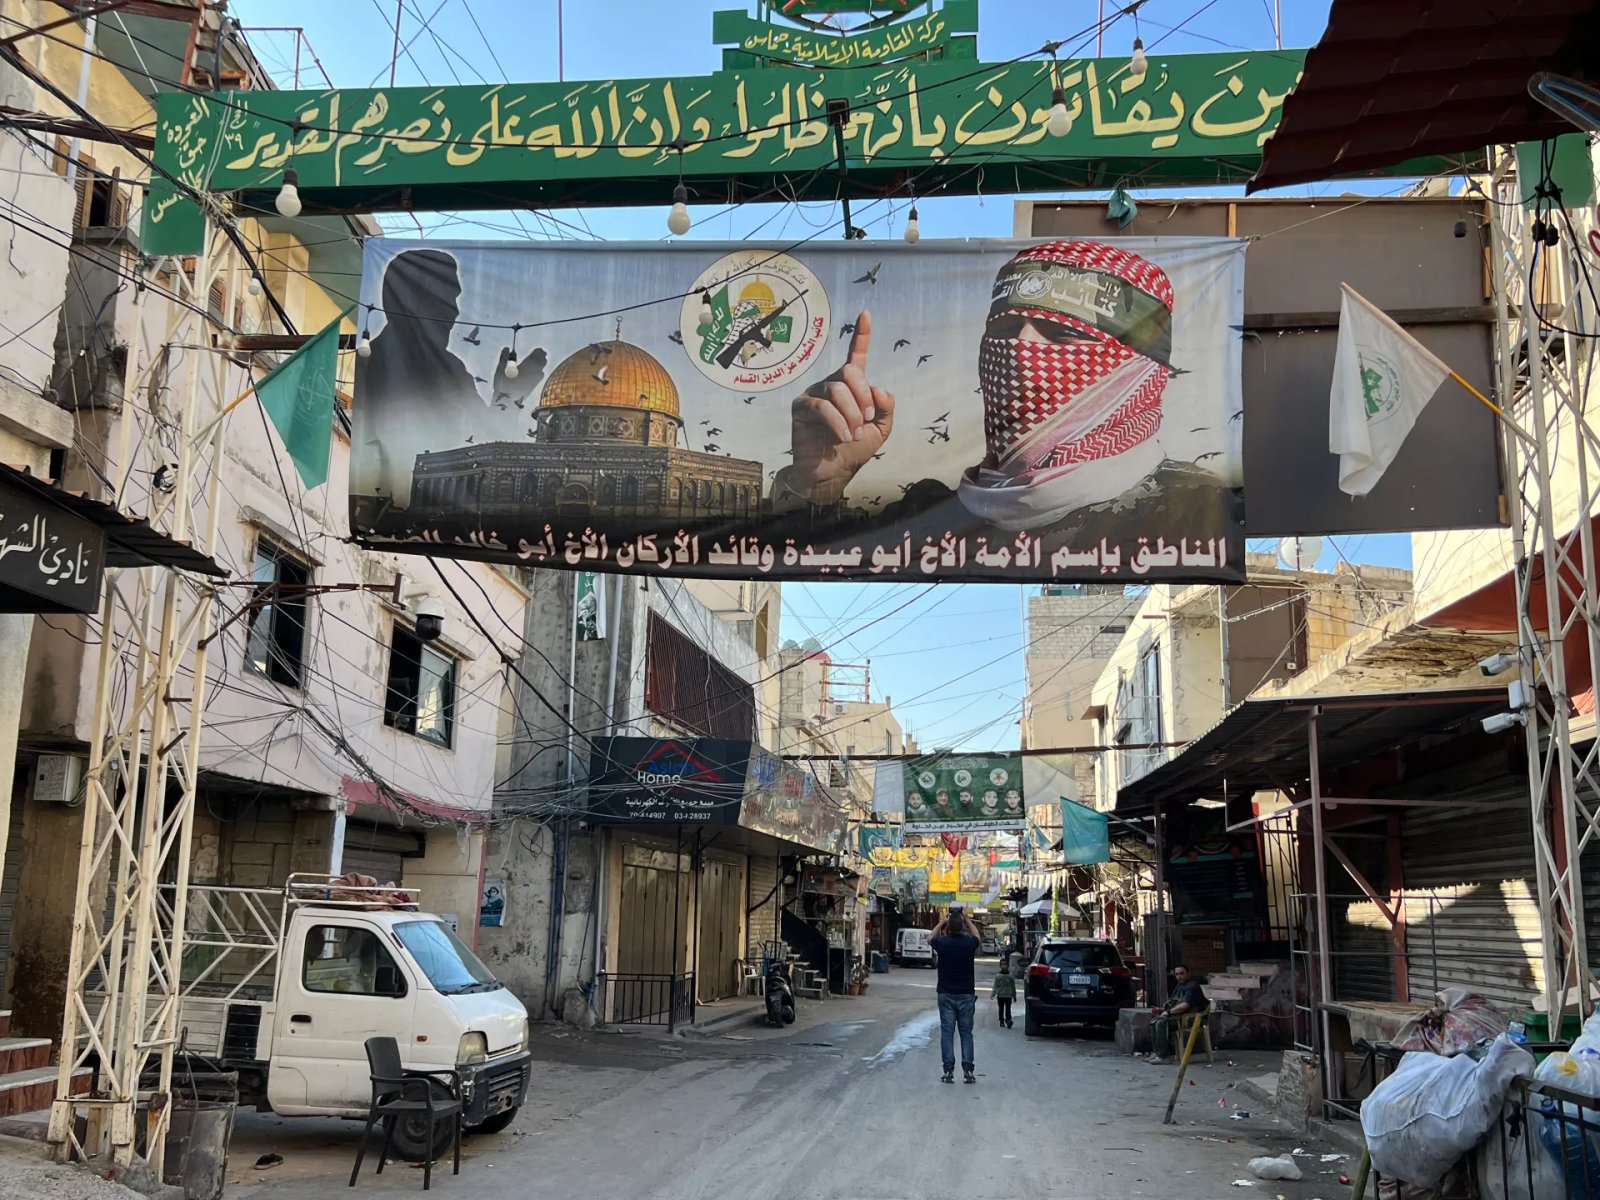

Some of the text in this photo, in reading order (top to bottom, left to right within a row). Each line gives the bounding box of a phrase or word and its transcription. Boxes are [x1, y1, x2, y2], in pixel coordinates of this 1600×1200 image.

[745, 29, 789, 50] حماس
[863, 25, 914, 58] المقاومة
[920, 12, 945, 44] حركة
[224, 132, 244, 150] ٣٩
[1050, 286, 1118, 319] كتائب
[1112, 284, 1122, 298] لا
[733, 316, 824, 385] كتائب الشهيد عز الدين القسام
[38, 535, 94, 586] نادي
[516, 523, 556, 561] أبو
[564, 526, 609, 565] الأخ
[616, 529, 699, 569] الأركان
[708, 534, 776, 573] وقائد
[782, 538, 864, 575] عبيدة
[868, 530, 911, 574] أبو
[919, 530, 966, 575] الأخ
[974, 530, 1041, 570] الأمة
[1051, 536, 1121, 577] بإسم
[1130, 535, 1227, 575] الناطق
[637, 771, 682, 784] Home
